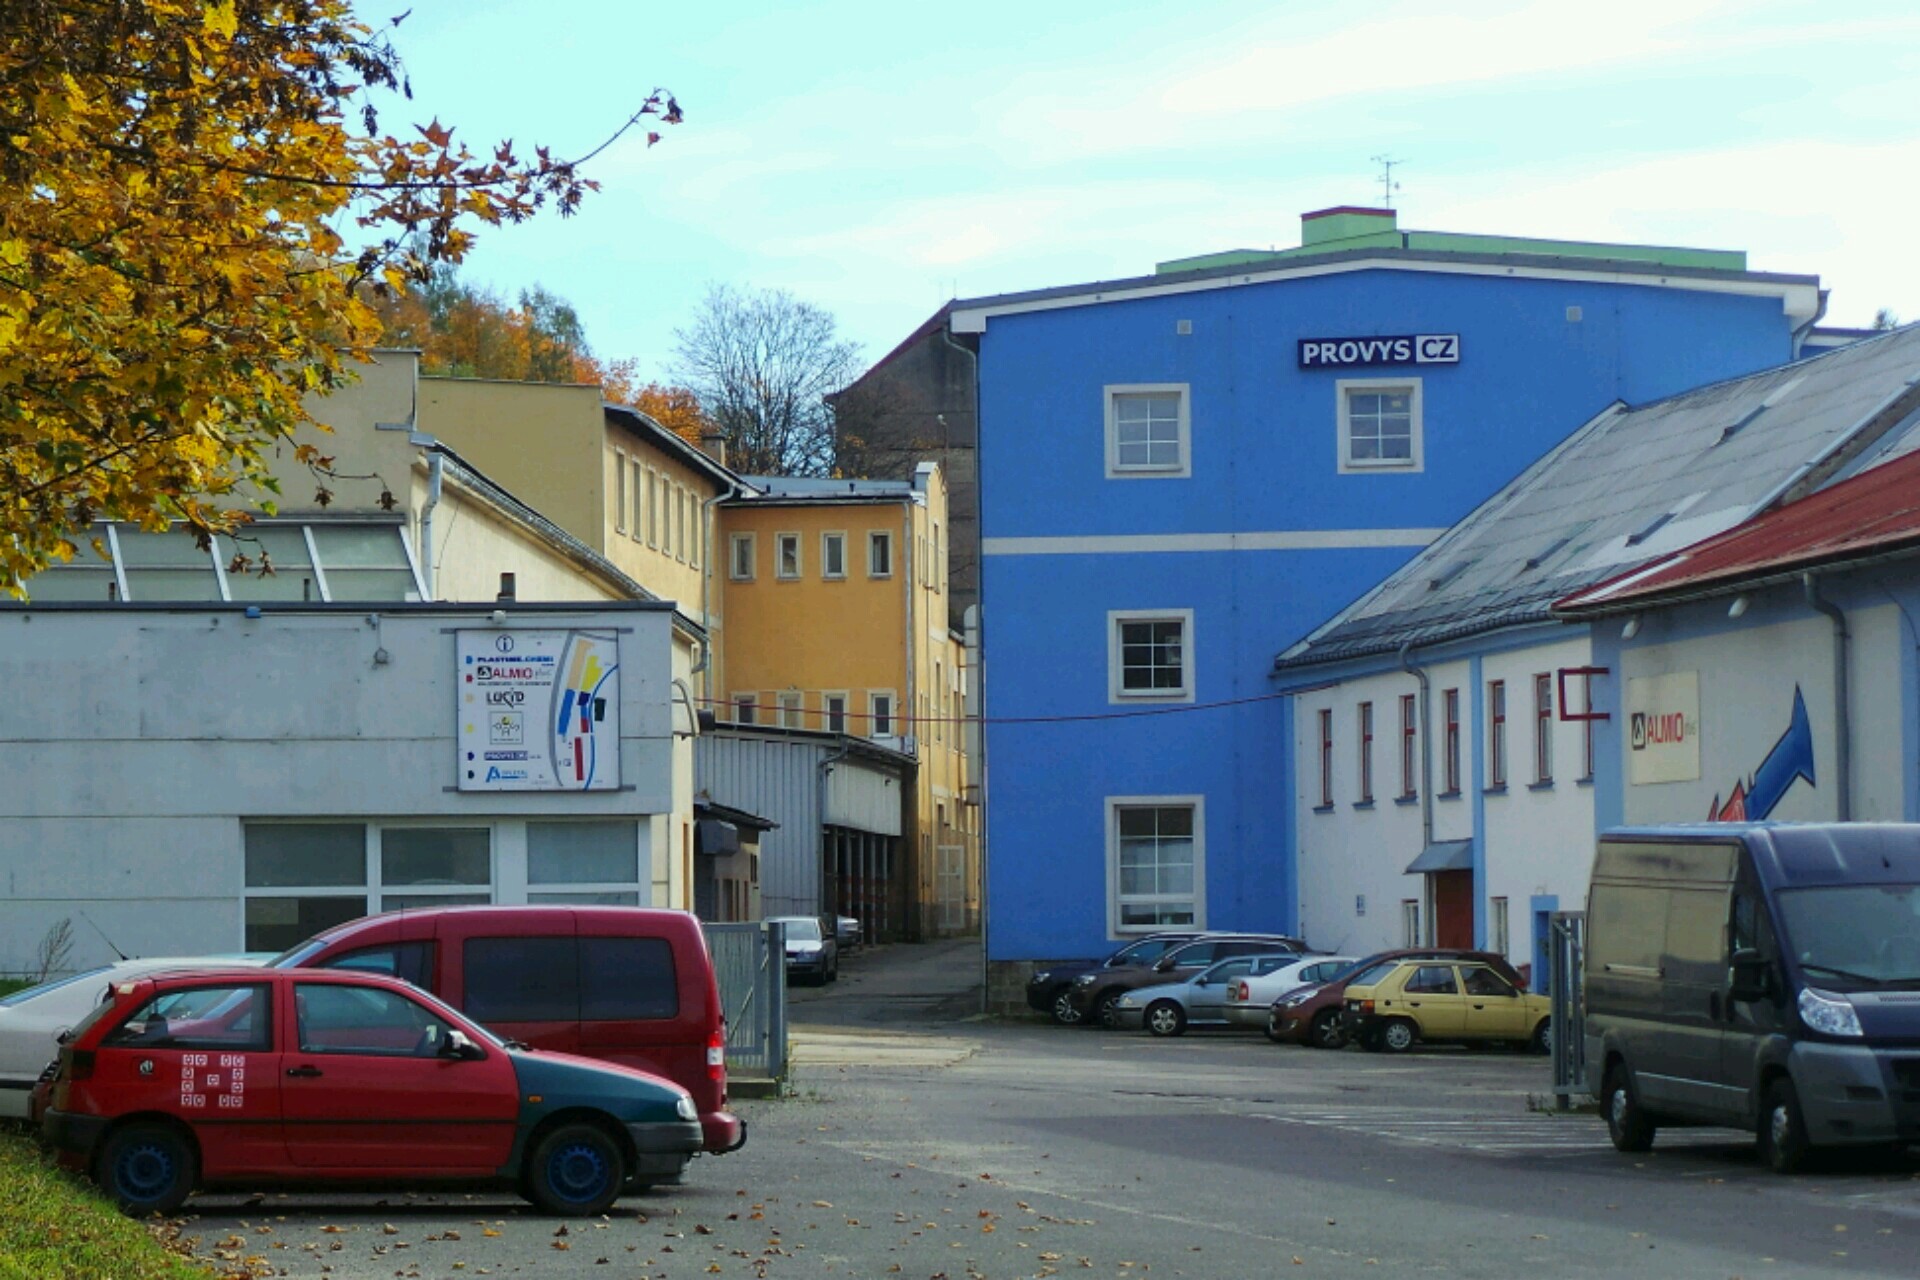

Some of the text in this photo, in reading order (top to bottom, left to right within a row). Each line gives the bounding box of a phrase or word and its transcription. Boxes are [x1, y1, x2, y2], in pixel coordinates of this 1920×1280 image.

[1303, 337, 1455, 364] PROVYS CZ
[1647, 712, 1684, 744] ALMIO
